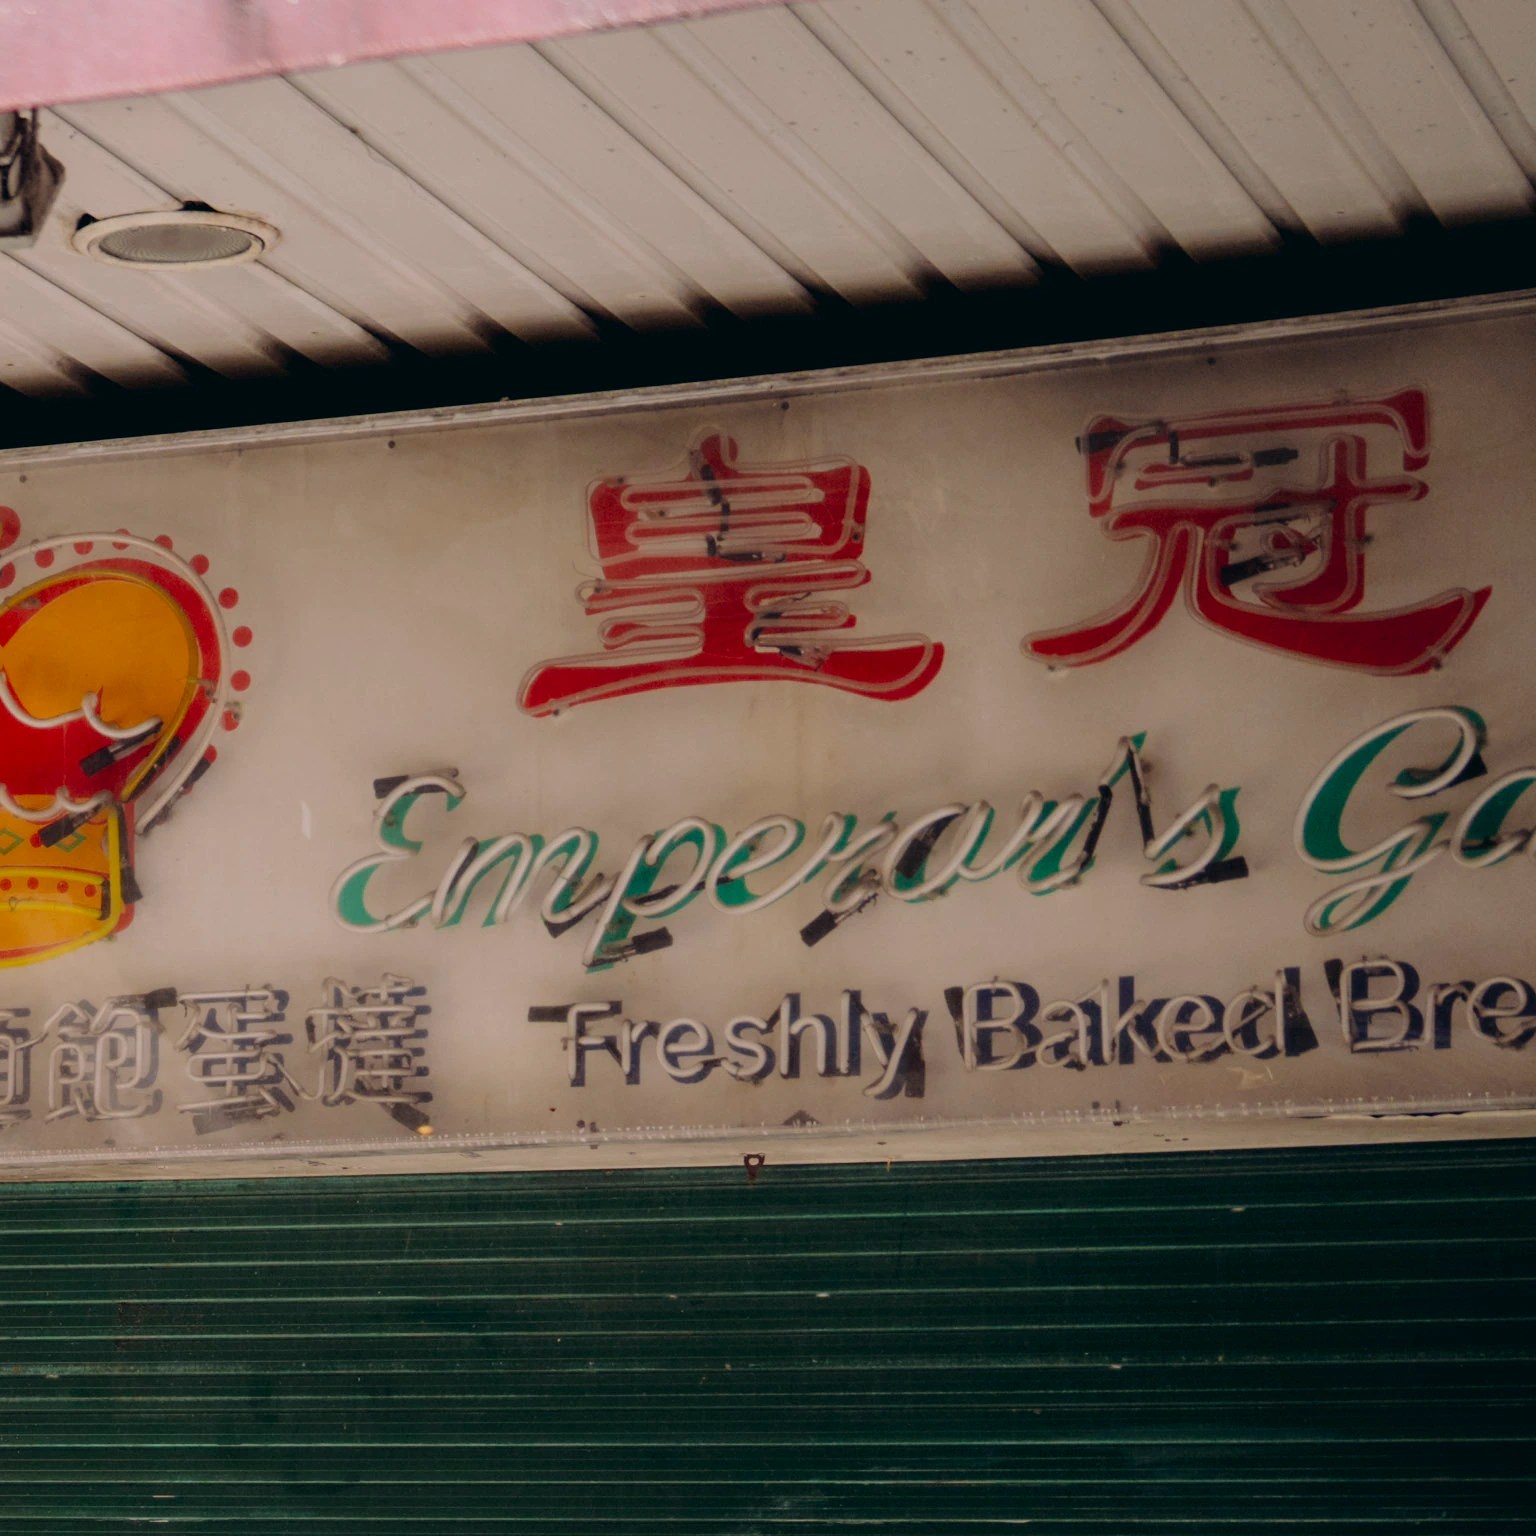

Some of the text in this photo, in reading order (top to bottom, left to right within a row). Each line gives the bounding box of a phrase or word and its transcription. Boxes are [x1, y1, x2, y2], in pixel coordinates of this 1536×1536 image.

[517, 384, 1493, 718] 皇冠
[332, 731, 1241, 971] Emperor's
[560, 990, 927, 1098] Freshly
[960, 966, 1301, 1074] Baked
